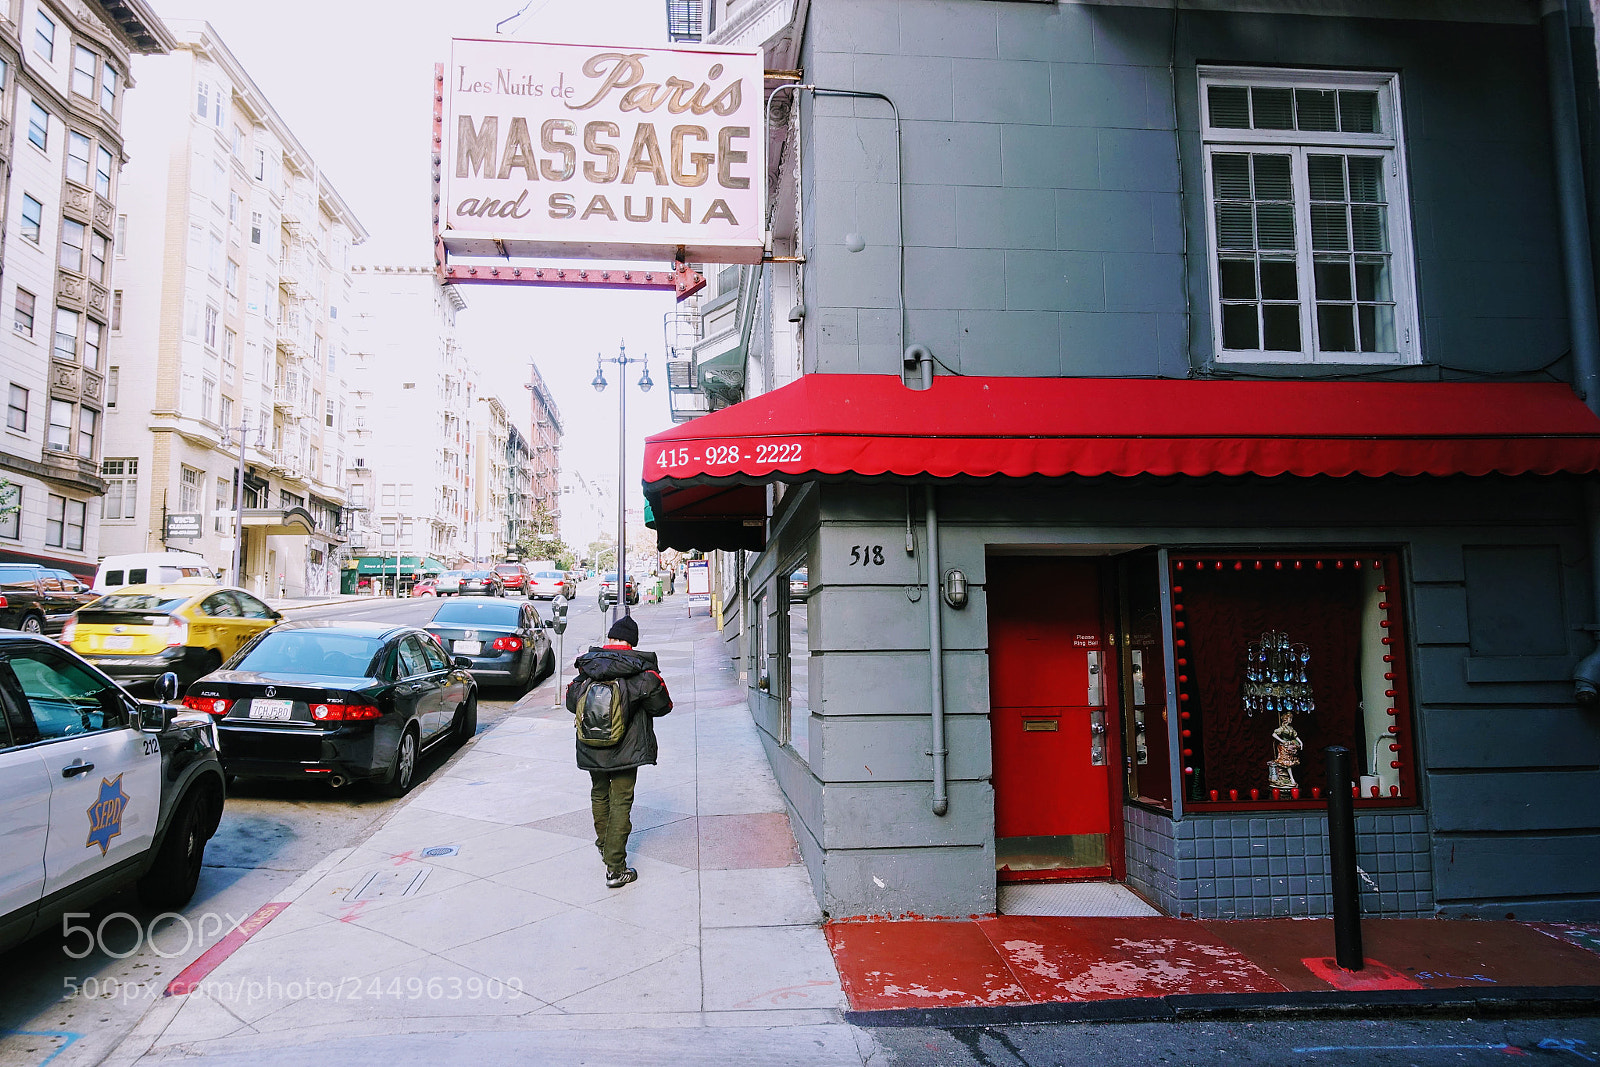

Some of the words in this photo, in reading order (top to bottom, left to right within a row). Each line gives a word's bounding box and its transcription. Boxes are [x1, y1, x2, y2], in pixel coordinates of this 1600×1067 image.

[457, 65, 492, 94] Les
[496, 67, 544, 98] Nuits
[550, 72, 575, 99] de
[564, 52, 743, 116] Paris
[456, 115, 750, 190] MASSAGE
[456, 188, 532, 220] and
[548, 192, 740, 226] SAUNA
[656, 448, 689, 468] 415
[706, 445, 740, 466] 928
[756, 443, 802, 464] 2222
[849, 544, 885, 566] 518
[143, 738, 159, 756] 212
